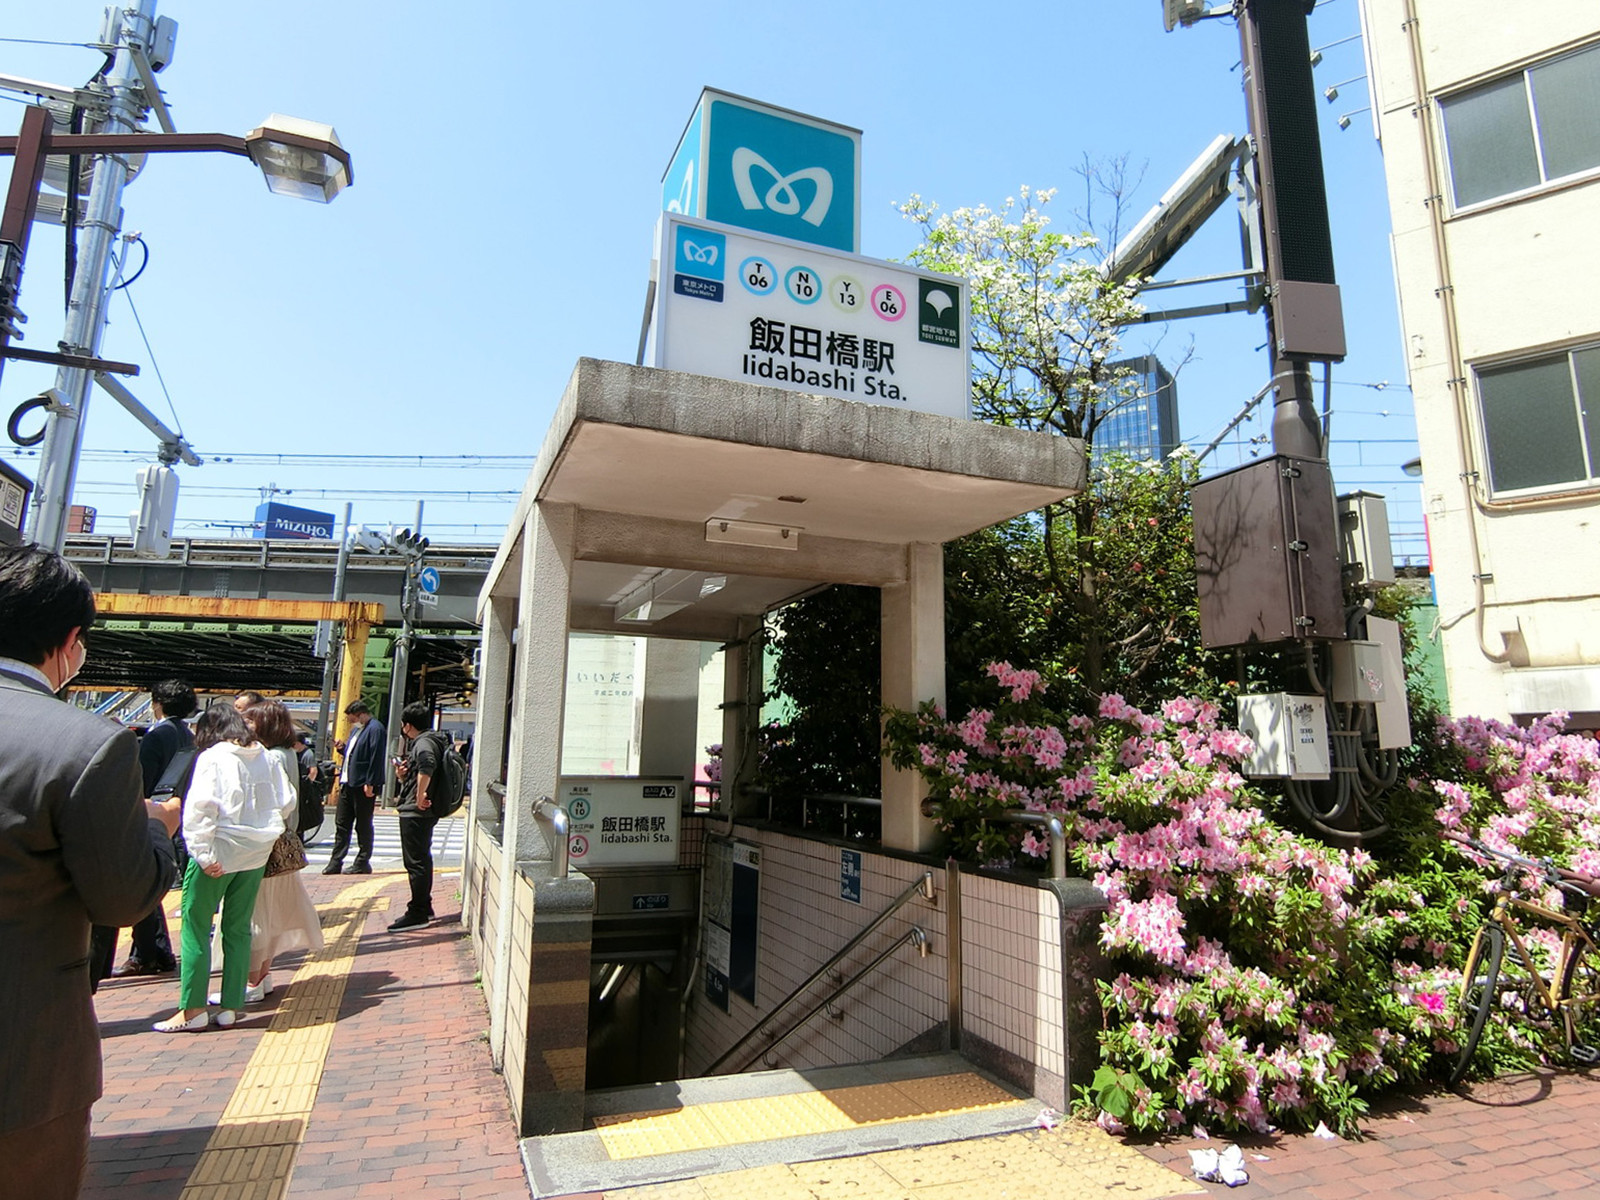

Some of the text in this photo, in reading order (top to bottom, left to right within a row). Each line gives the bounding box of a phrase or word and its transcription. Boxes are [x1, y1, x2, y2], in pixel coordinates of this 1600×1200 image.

[754, 262, 762, 274] T
[748, 274, 768, 288] 06
[798, 272, 809, 284] N
[796, 284, 812, 298] 10
[842, 282, 852, 292] Y
[839, 292, 855, 306] 13
[885, 290, 892, 302] E
[880, 301, 898, 315] 06
[749, 316, 895, 376] 飯田橋駅
[743, 354, 907, 402] Iidabashi Sta.
[275, 518, 326, 537] MIZUHO
[659, 787, 674, 797] A2
[601, 816, 665, 832] 飯田橋駅
[601, 833, 673, 843] Iidabashi Sta.
[572, 845, 583, 853] 06
